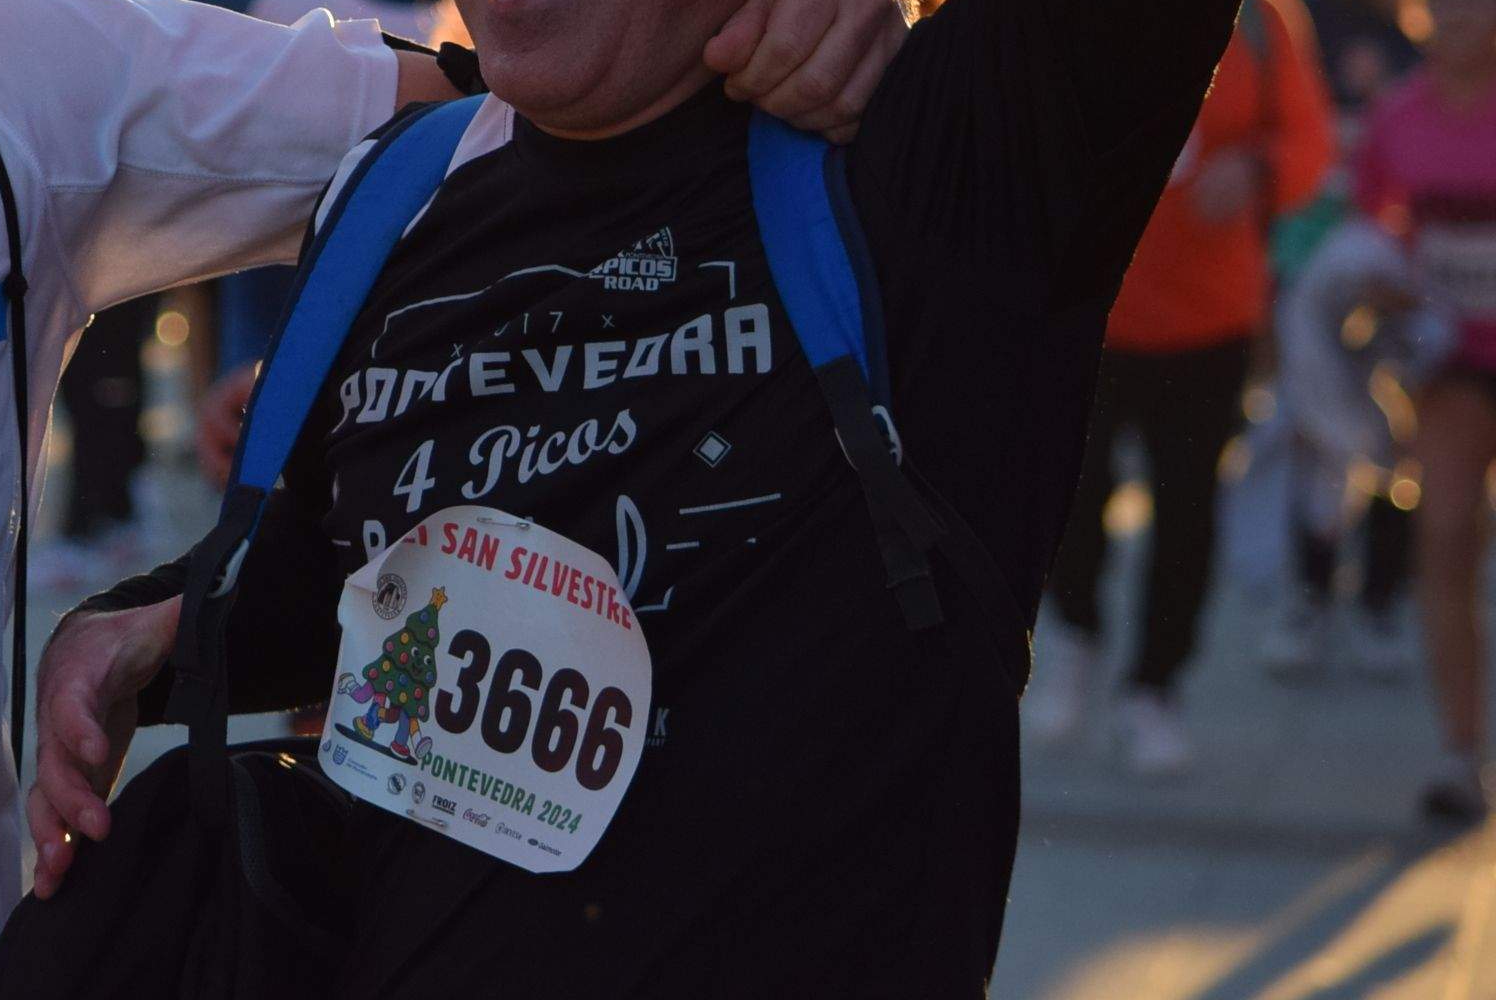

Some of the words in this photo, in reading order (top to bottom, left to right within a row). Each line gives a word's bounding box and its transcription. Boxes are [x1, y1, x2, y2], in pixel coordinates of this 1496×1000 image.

[603, 257, 672, 277] PICOS
[604, 276, 659, 291] ROAD
[393, 439, 436, 513] 4
[461, 408, 637, 499] Picos
[441, 522, 500, 571] SAN
[434, 629, 632, 791] 3666
[420, 750, 534, 816] PONTEVEDRA
[537, 800, 583, 835] 2024
[433, 795, 457, 811] FROIZ
